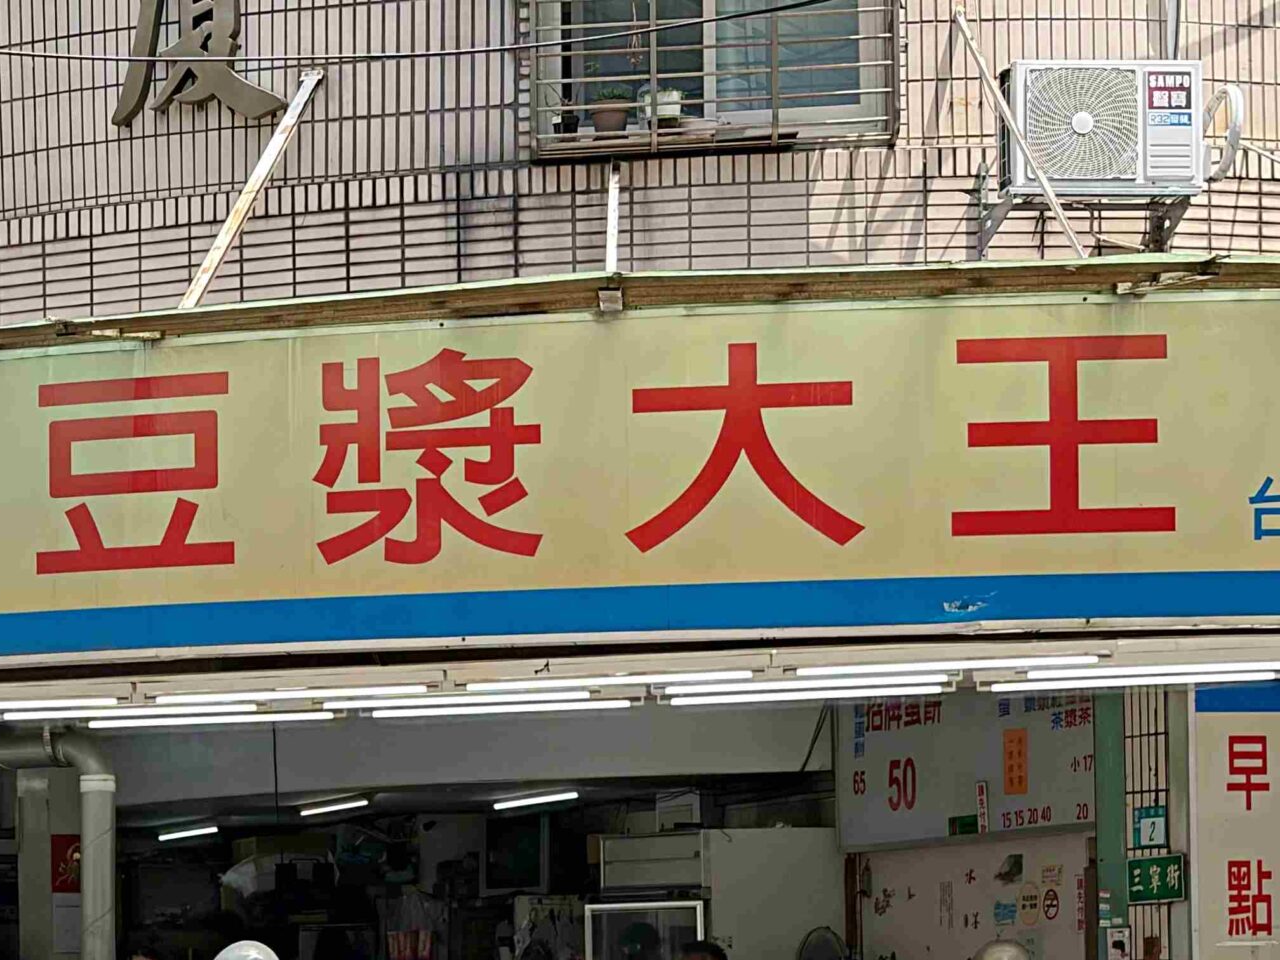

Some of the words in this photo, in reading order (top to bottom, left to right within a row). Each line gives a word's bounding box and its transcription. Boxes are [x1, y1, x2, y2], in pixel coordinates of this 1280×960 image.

[1149, 75, 1190, 88] SAMPO
[1082, 754, 1094, 772] 17
[853, 770, 866, 795] 65
[887, 757, 916, 811] 50
[1002, 812, 1012, 829] 15
[1014, 810, 1025, 827] 15
[1027, 807, 1039, 825] 20
[1041, 805, 1052, 822] 40
[1076, 803, 1089, 820] 20
[1148, 821, 1156, 842] 2
